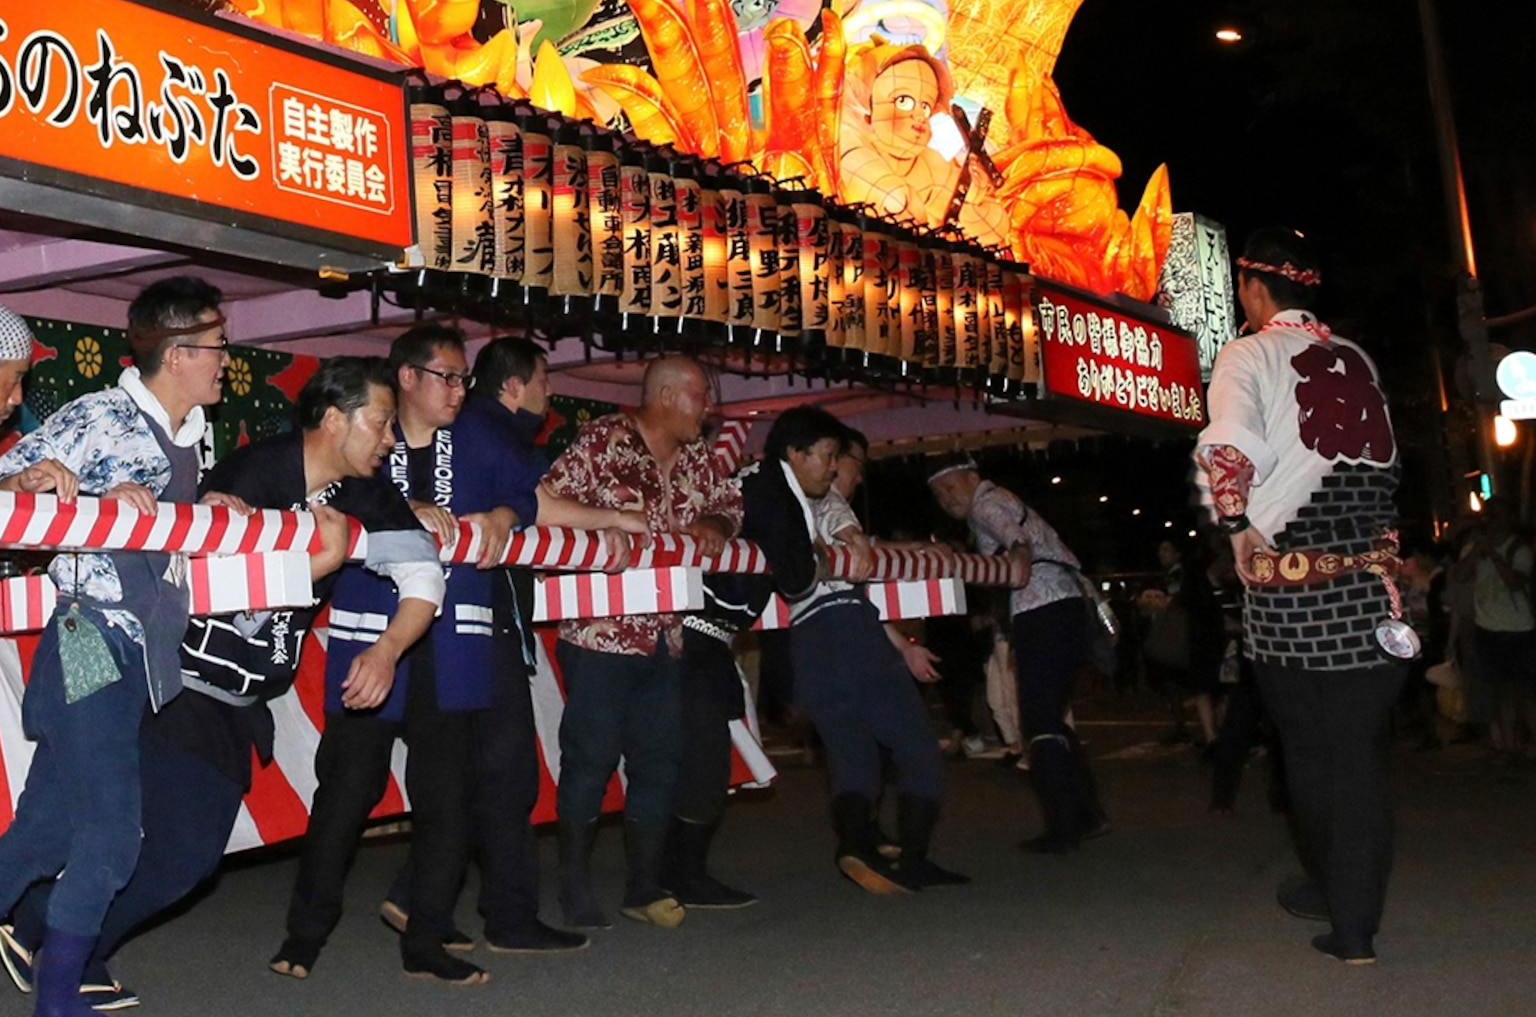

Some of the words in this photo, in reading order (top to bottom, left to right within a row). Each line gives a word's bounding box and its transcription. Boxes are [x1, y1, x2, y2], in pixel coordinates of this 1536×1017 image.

[282, 94, 378, 157] 自主製作
[278, 138, 388, 207] 実行委員会
[1075, 356, 1203, 422] ありがとうございました
[390, 442, 410, 501] ENEO
